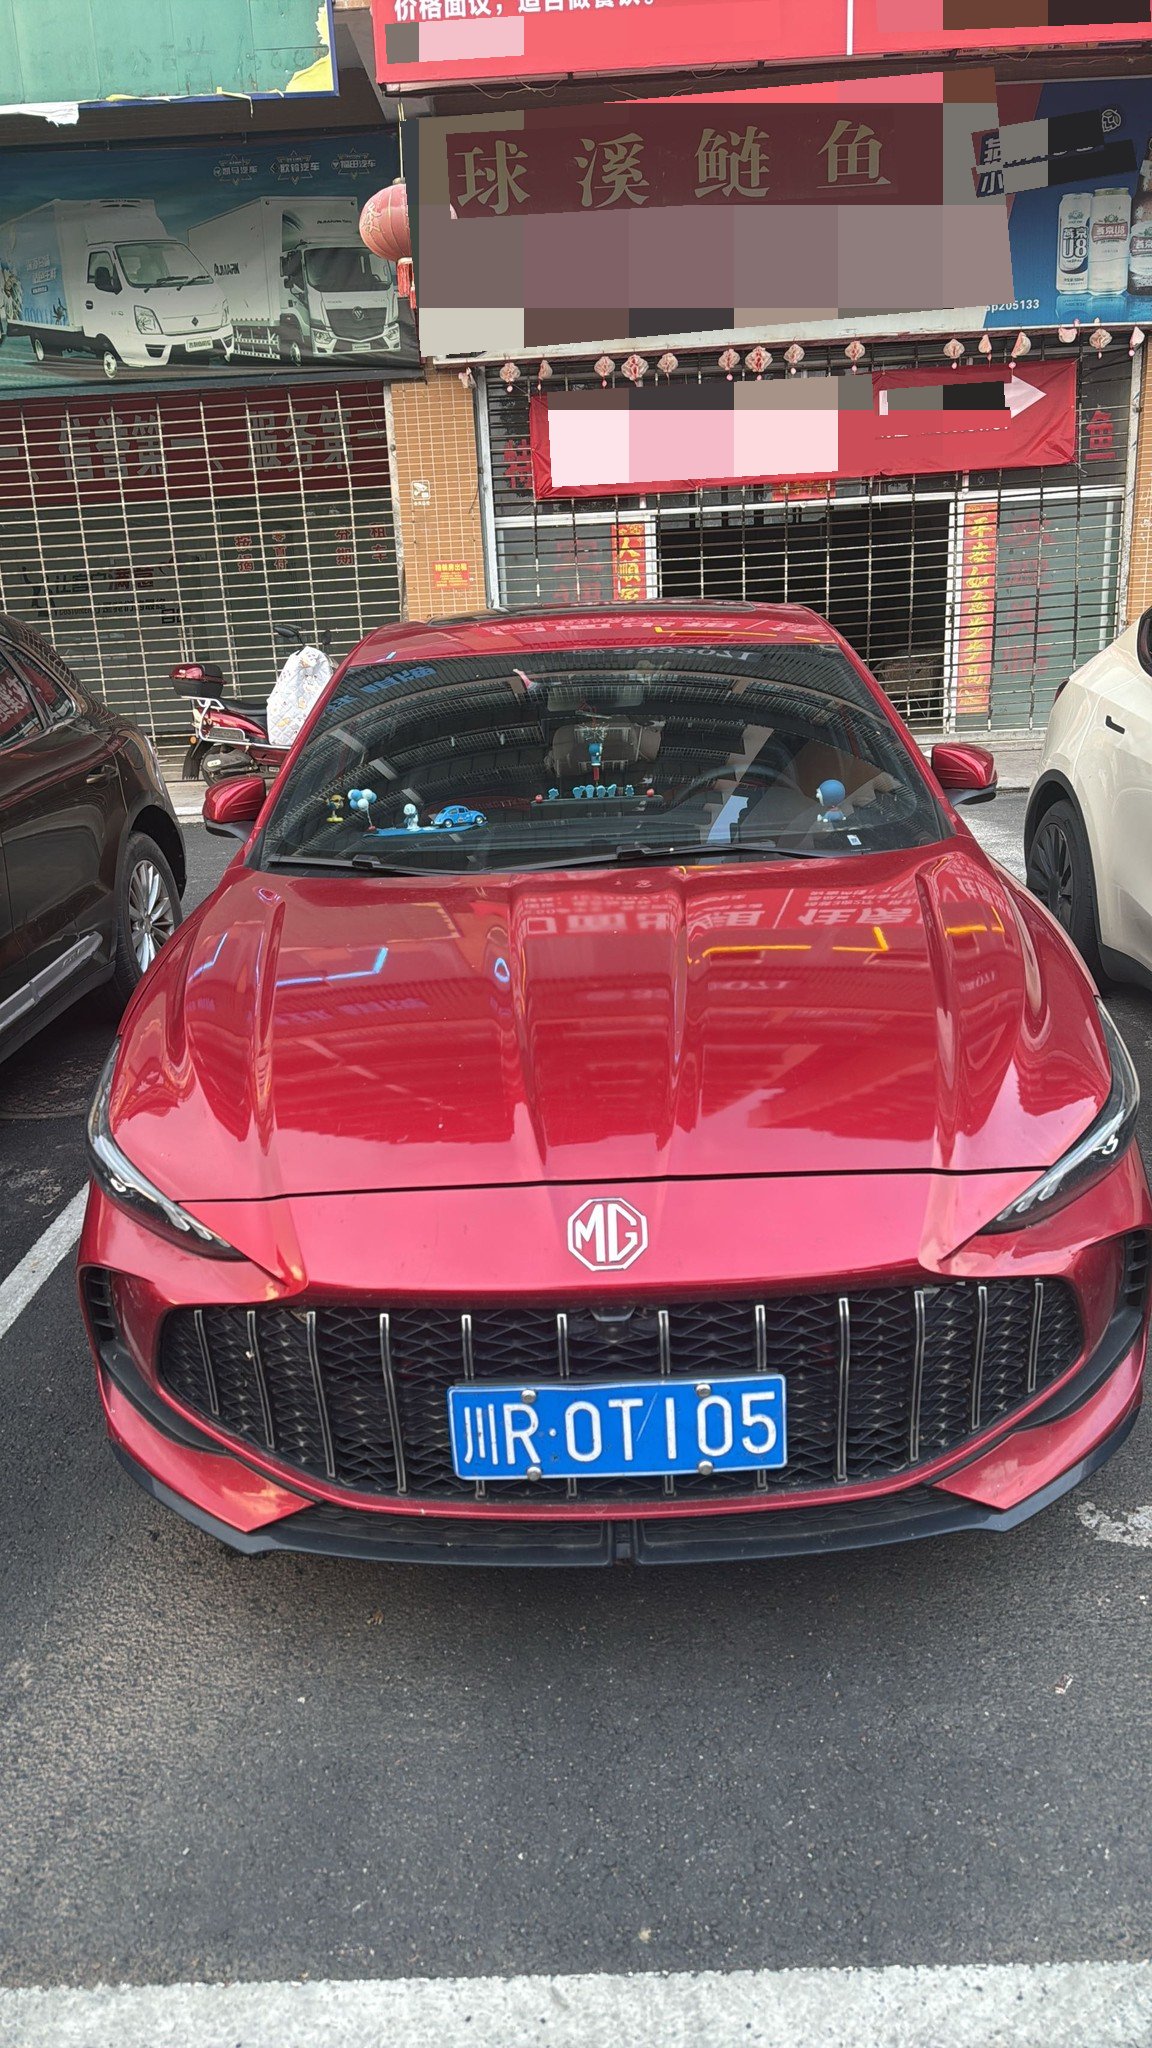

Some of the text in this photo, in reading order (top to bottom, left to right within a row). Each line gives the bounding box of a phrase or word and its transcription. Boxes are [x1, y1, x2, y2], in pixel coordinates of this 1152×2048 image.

[455, 119, 891, 214] 球溪鲢鱼
[1062, 238, 1088, 258] U8
[574, 1203, 638, 1263] MG
